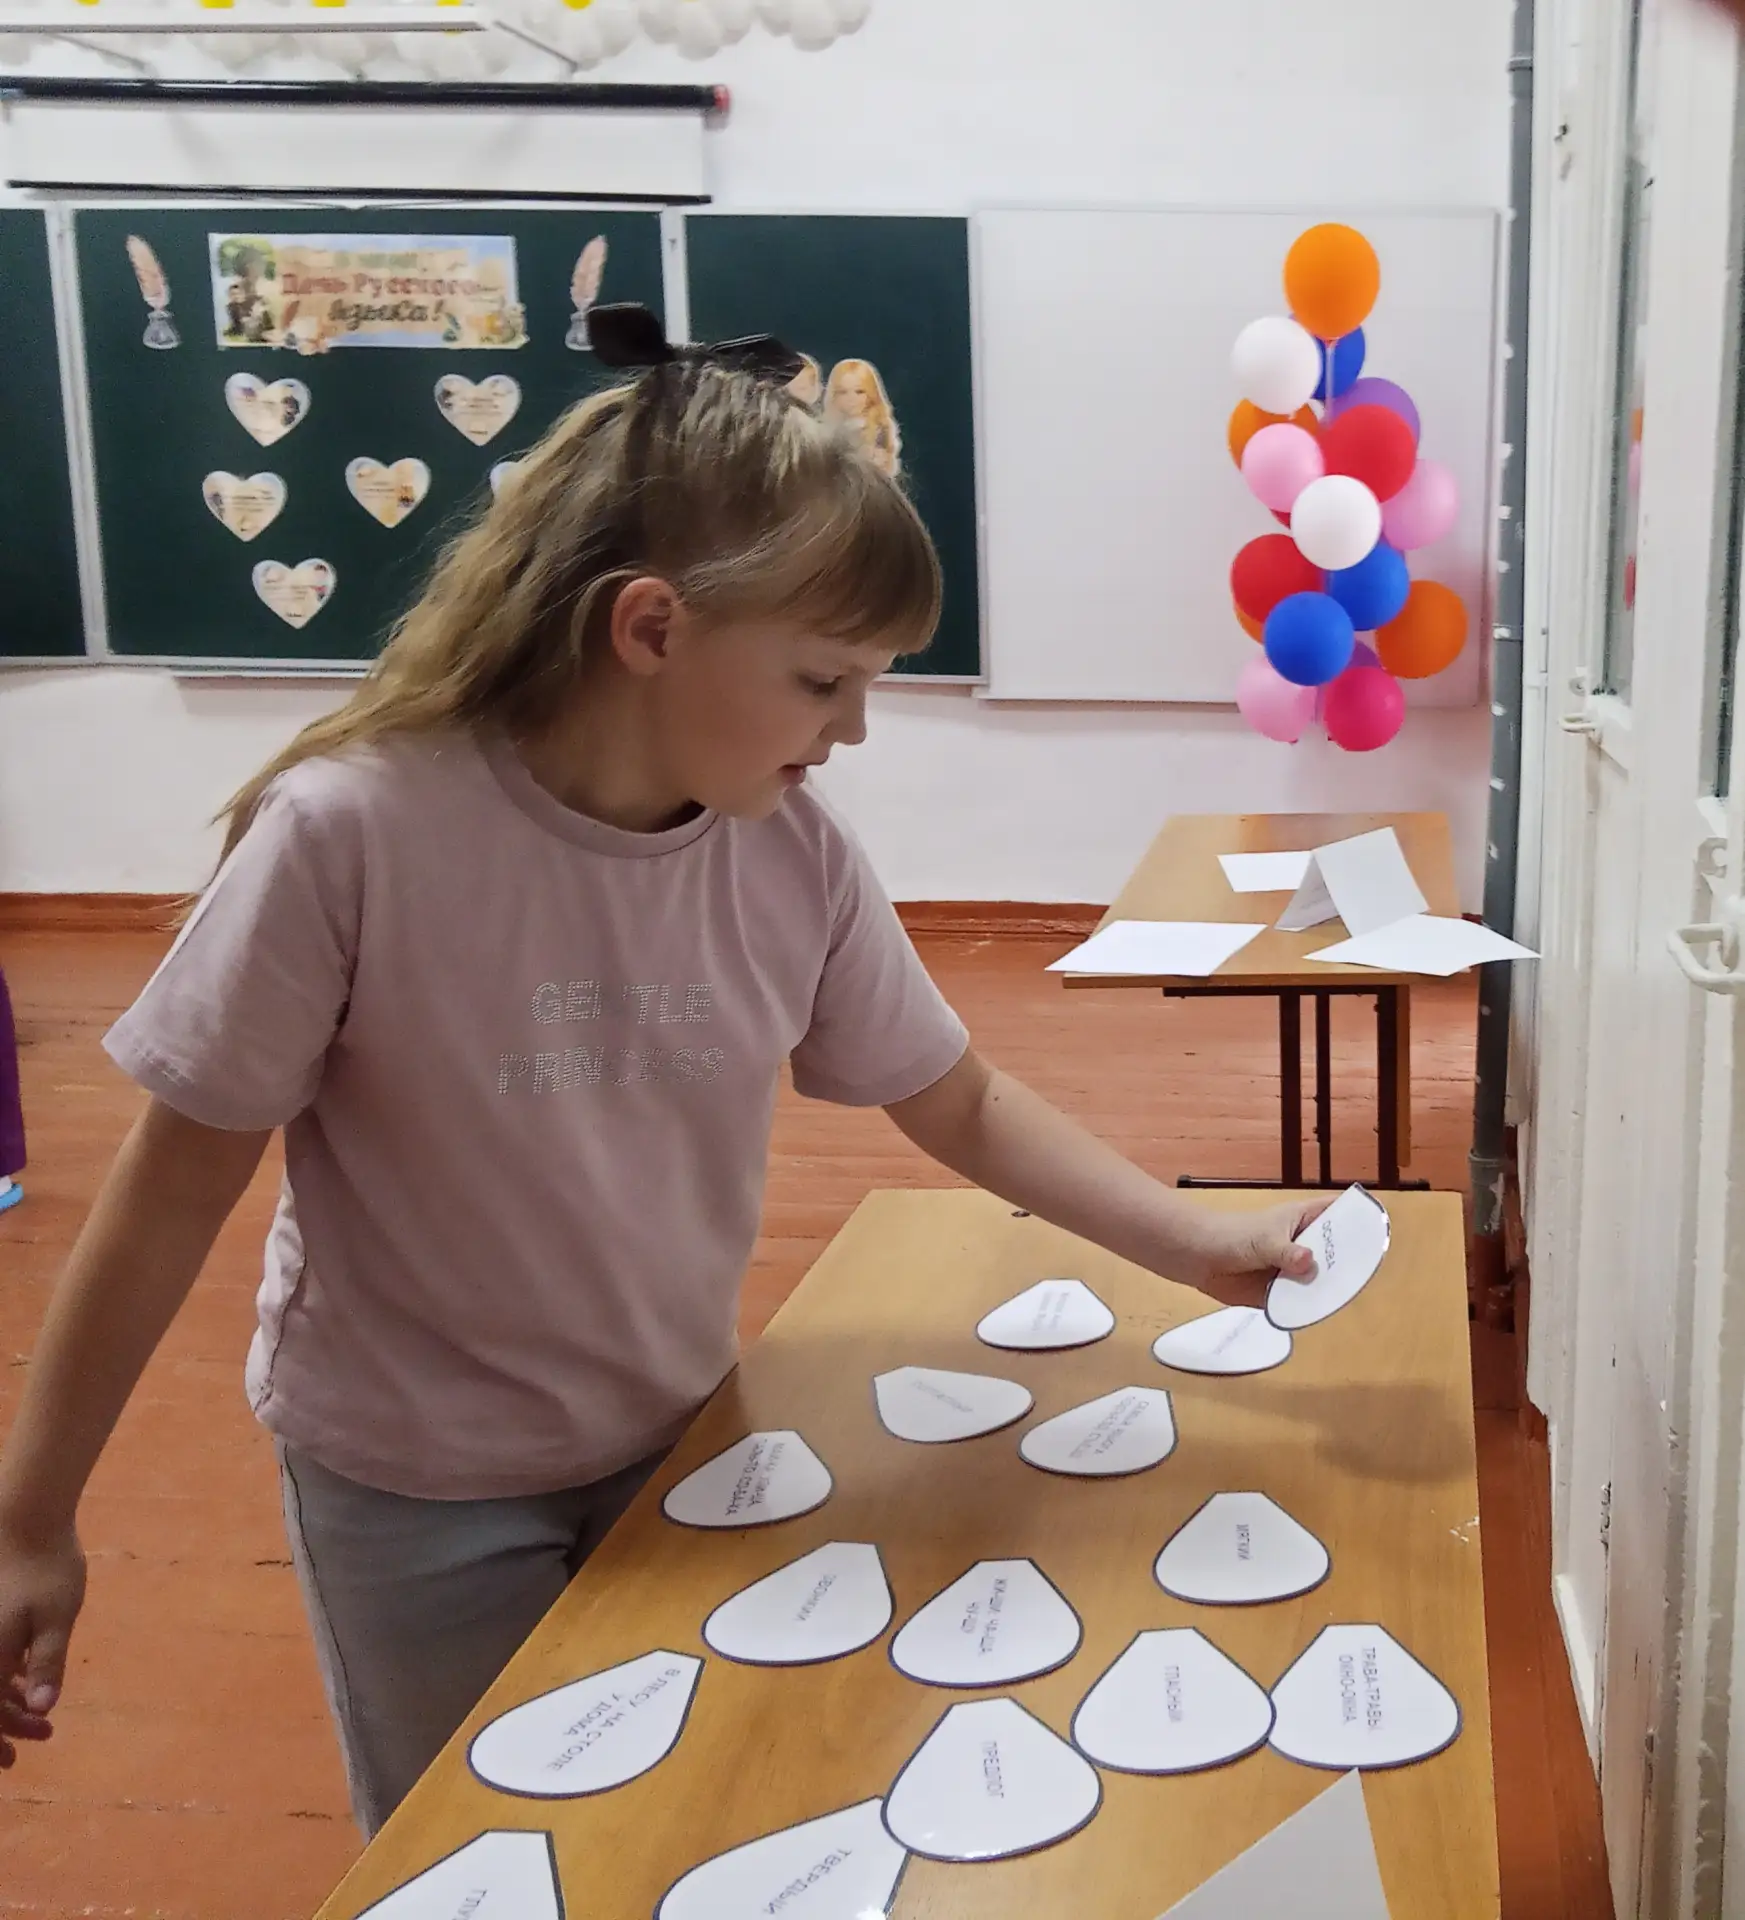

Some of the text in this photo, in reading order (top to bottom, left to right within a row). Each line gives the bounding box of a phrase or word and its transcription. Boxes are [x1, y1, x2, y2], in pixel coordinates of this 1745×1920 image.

[530, 979, 713, 1025] GETLE
[1322, 1219, 1336, 1271] ОСНОВА
[664, 1668, 681, 1678] В
[563, 1701, 612, 1736] ДОМА
[600, 1710, 628, 1728] НА
[546, 1730, 602, 1772] СТОЛЕ
[980, 1740, 1004, 1799] ПРЕДЛОГ
